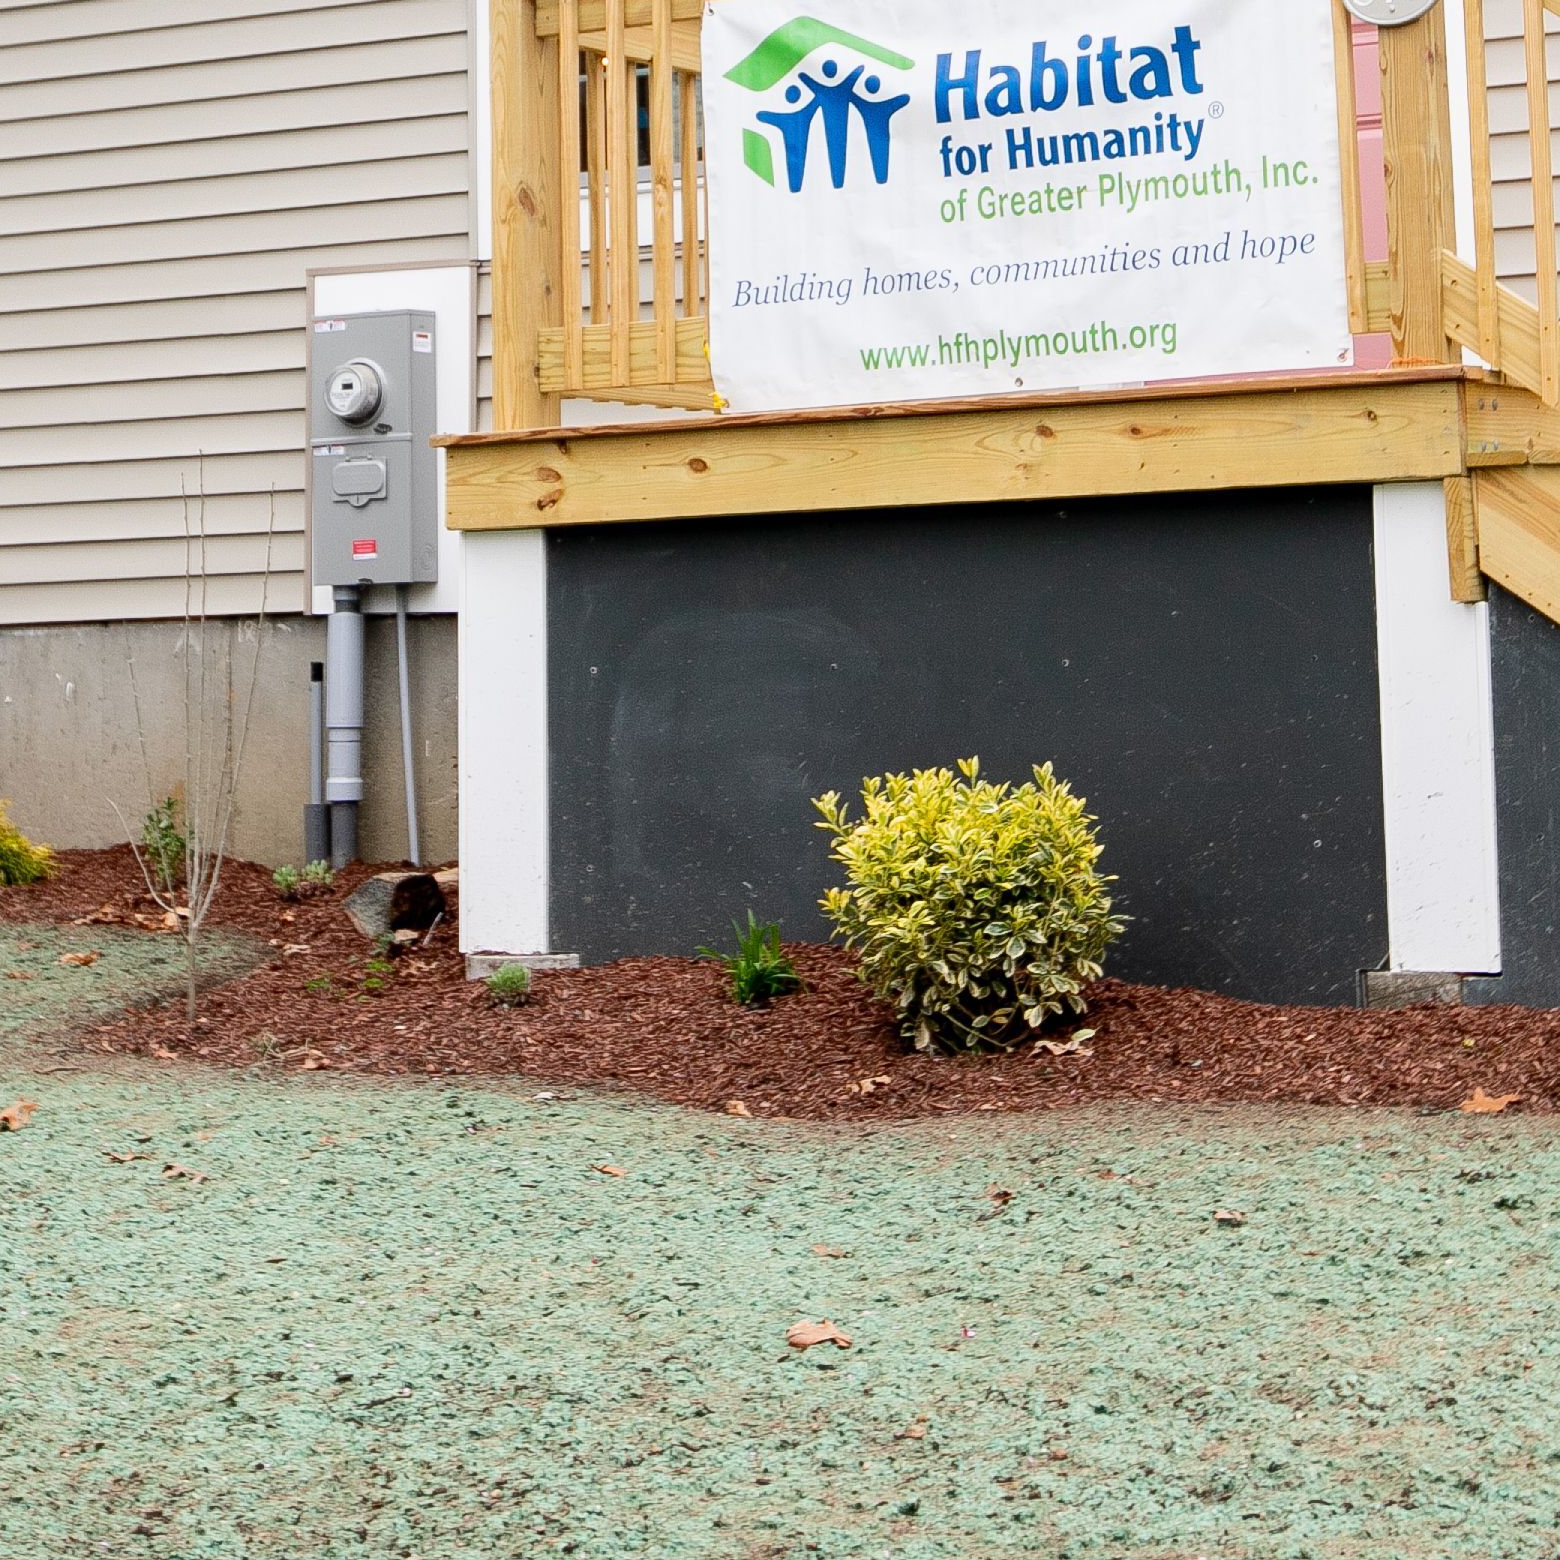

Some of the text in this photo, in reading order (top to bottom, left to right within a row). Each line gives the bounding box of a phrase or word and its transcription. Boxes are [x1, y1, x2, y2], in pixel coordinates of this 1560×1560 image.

[935, 25, 1204, 124] Habitat
[940, 111, 1205, 177] for Humanity
[941, 155, 1318, 224] of Greater Plymouth, Inc.
[732, 229, 1316, 308] Building homes, communities and hope
[860, 320, 1177, 371] www.hfhplymouth.org
